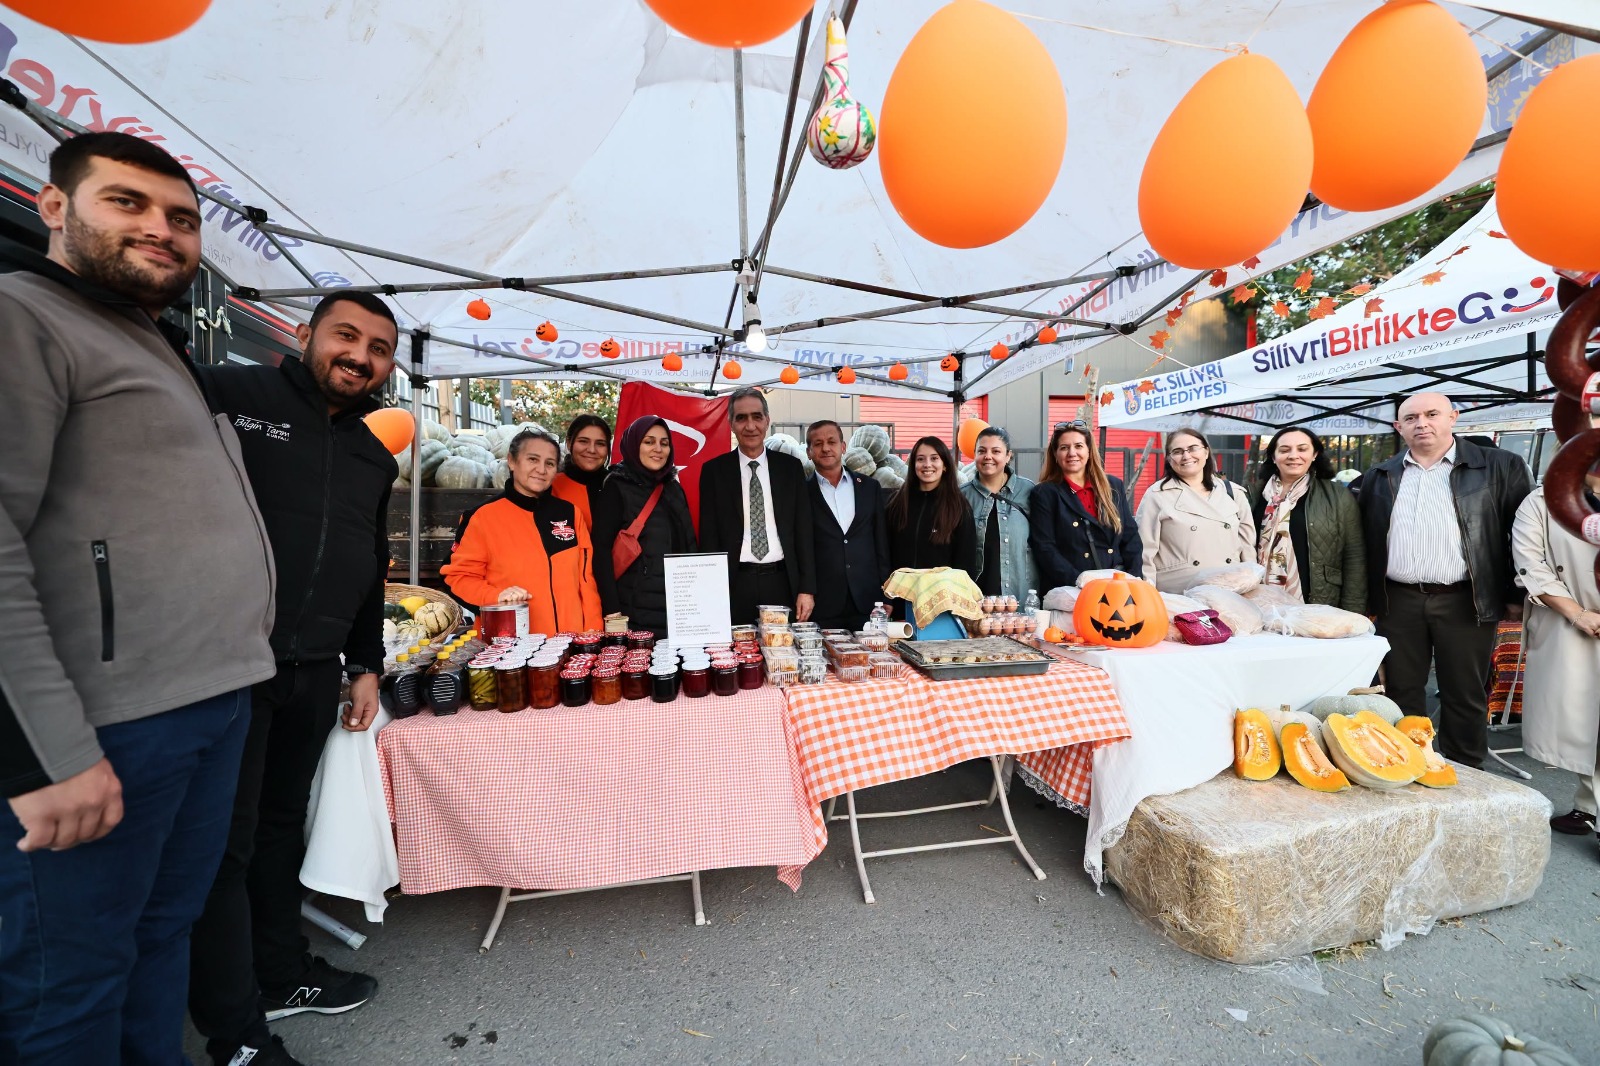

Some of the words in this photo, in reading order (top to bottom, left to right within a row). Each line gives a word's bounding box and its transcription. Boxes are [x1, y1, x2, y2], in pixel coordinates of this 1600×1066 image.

[1327, 359, 1367, 375] DOĞASI
[1369, 355, 1384, 365] VE
[1384, 336, 1462, 360] KÜLTÜRÜYLE
[1464, 328, 1495, 343] HEP
[1169, 361, 1224, 390] SİLİVRİ
[1144, 381, 1227, 411] BELEDİYESİ
[234, 418, 262, 431] Bilgin
